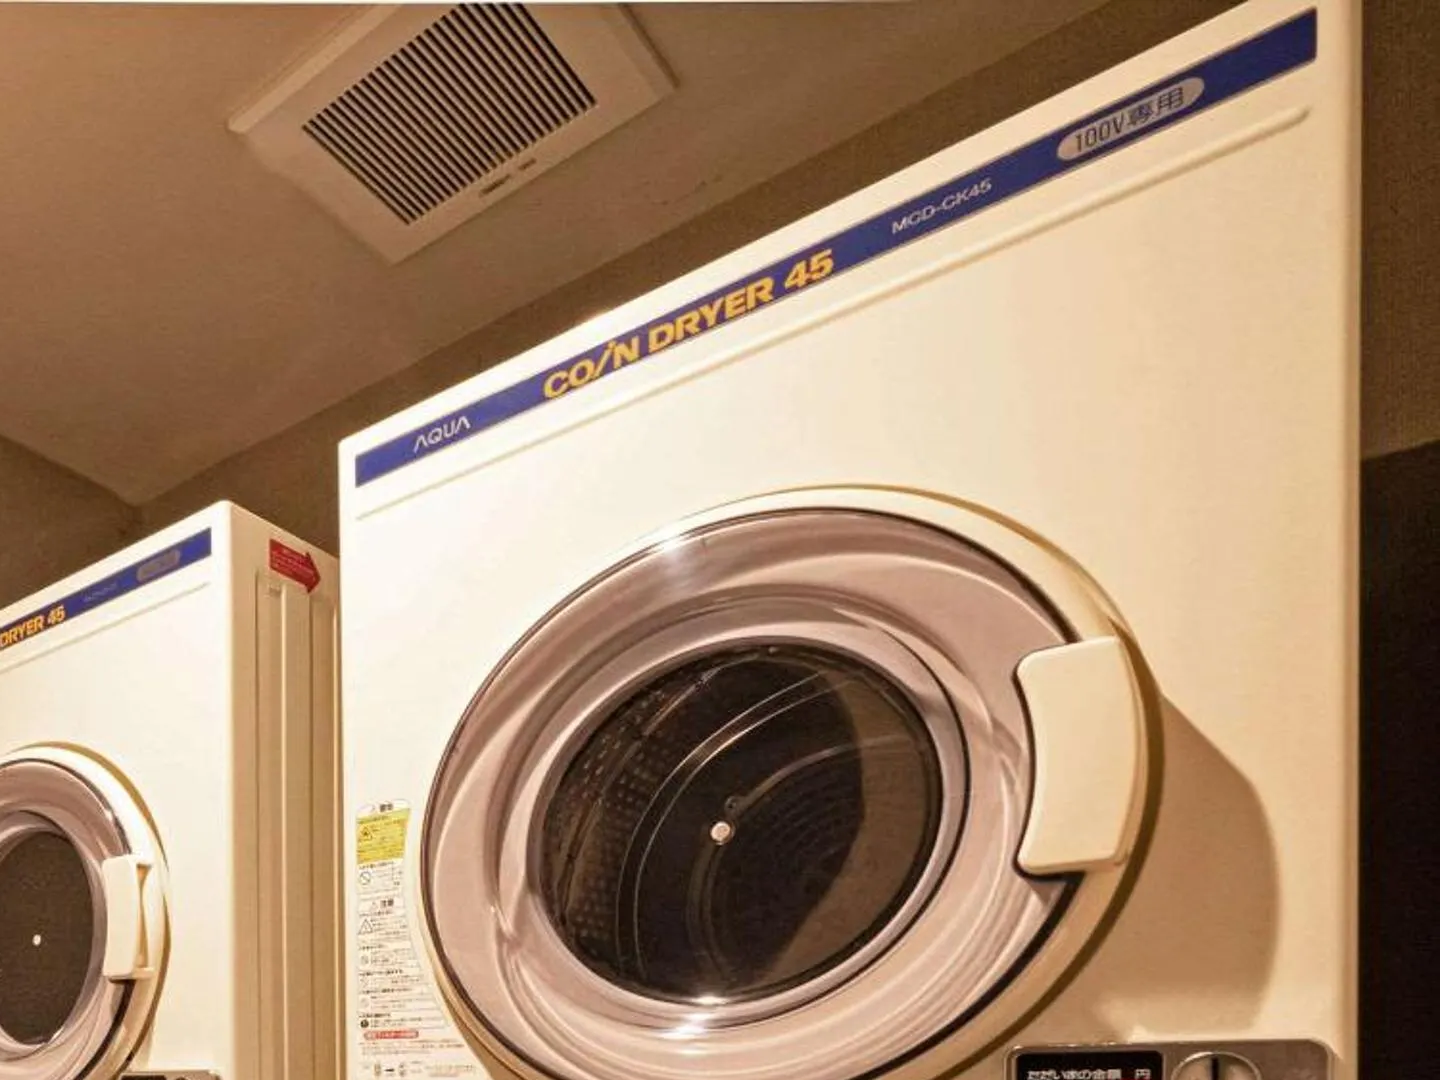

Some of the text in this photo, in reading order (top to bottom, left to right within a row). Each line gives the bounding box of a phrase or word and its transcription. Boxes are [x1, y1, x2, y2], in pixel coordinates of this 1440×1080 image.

[1073, 84, 1186, 155] 100V専用
[891, 178, 993, 235] MGD-CK45
[647, 275, 775, 353] DRYER
[784, 249, 834, 290] 45
[413, 416, 472, 452] AQUA
[46, 605, 67, 625] 45
[1133, 1069, 1152, 1080] 円
